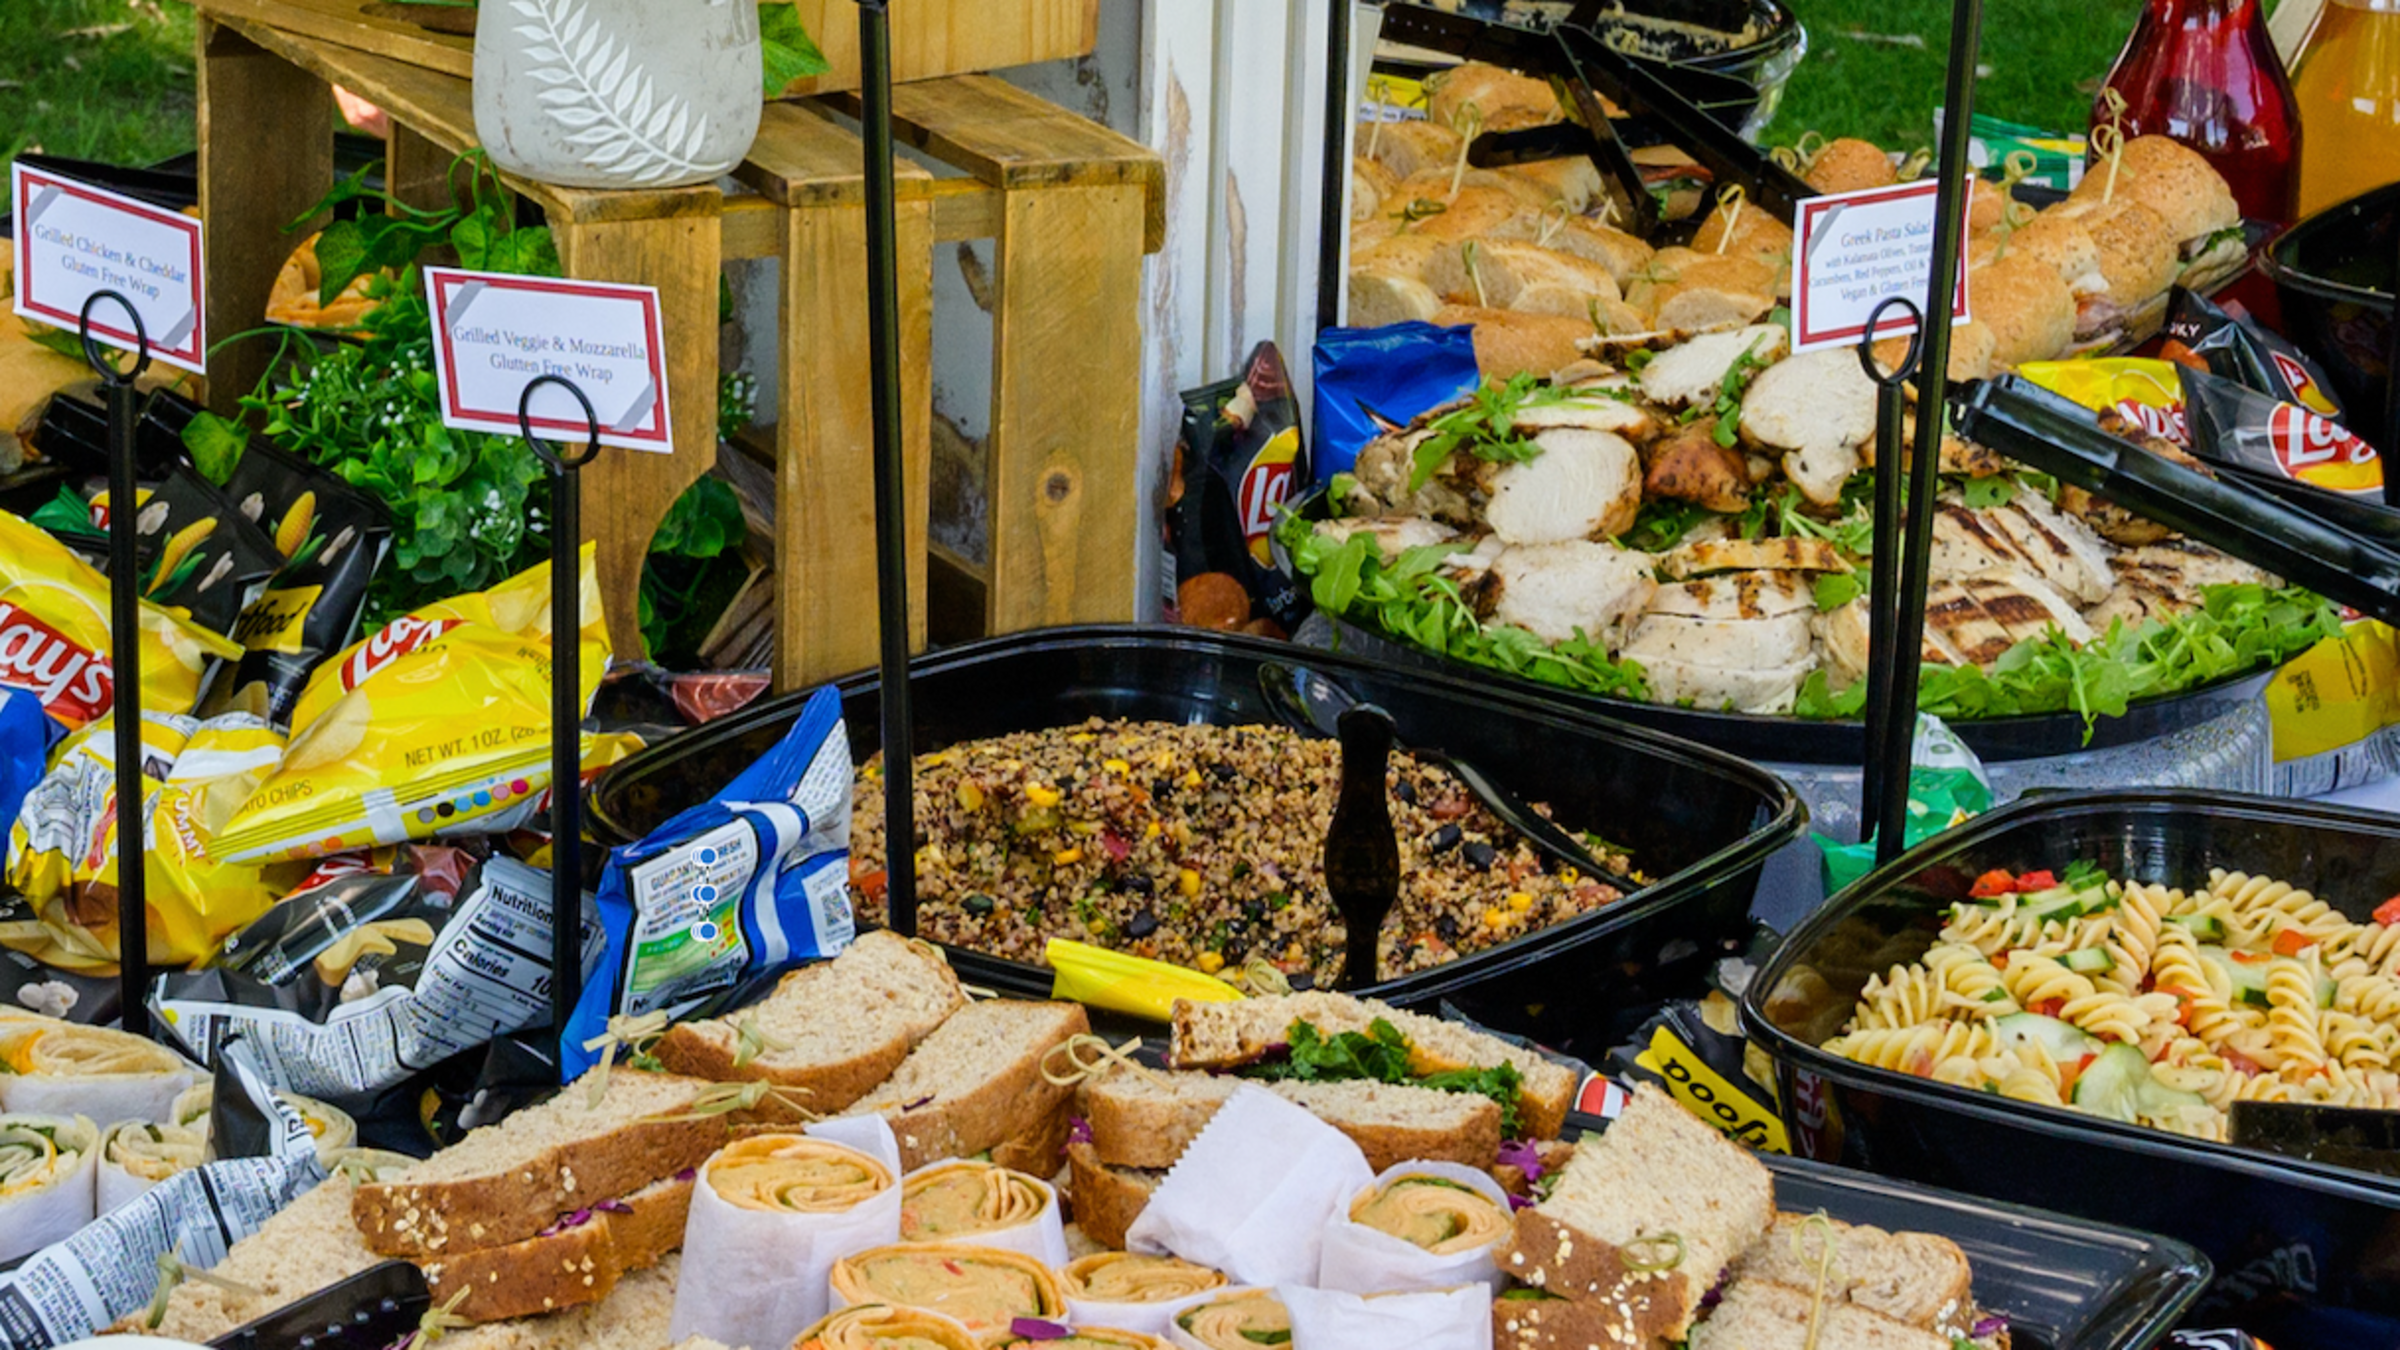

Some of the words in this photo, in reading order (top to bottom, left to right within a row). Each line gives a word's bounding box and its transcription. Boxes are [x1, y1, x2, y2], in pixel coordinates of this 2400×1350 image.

[35, 224, 73, 248] Grilled
[76, 237, 122, 263] Chicken
[125, 253, 136, 267] &
[139, 257, 186, 283] Cheddar
[1826, 257, 1841, 268] with
[1908, 243, 1932, 254] Toma
[1841, 230, 1872, 247] Greek
[1875, 228, 1901, 242] Pasta
[62, 255, 99, 278] Gluten
[101, 267, 127, 288] Free
[129, 276, 160, 301] Wrap
[1855, 268, 1869, 280] Red
[1904, 260, 1916, 272] Oil
[1840, 286, 1867, 301] Vegan
[1869, 284, 1877, 296] &
[1880, 280, 1909, 294] Gluten
[453, 325, 500, 345] Grilled
[503, 330, 549, 353] Veggie
[552, 337, 565, 351] &
[569, 338, 645, 360] Mozzarella
[490, 353, 540, 373] Glutten
[543, 359, 572, 377] Free
[575, 363, 613, 384] Wrap
[1246, 465, 1292, 536] La
[405, 747, 435, 768] NET
[438, 739, 467, 759] WT.
[472, 735, 479, 750] 1
[482, 729, 508, 748] OZ.
[269, 780, 313, 805] CHIPS
[492, 885, 553, 925] Nutrition
[454, 938, 510, 978] Calories
[531, 974, 553, 1000] 10
[35, 1263, 74, 1314] SMARTFOODS,
[44, 1256, 88, 1318] MANUFACTURED
[48, 1293, 59, 1305] TX
